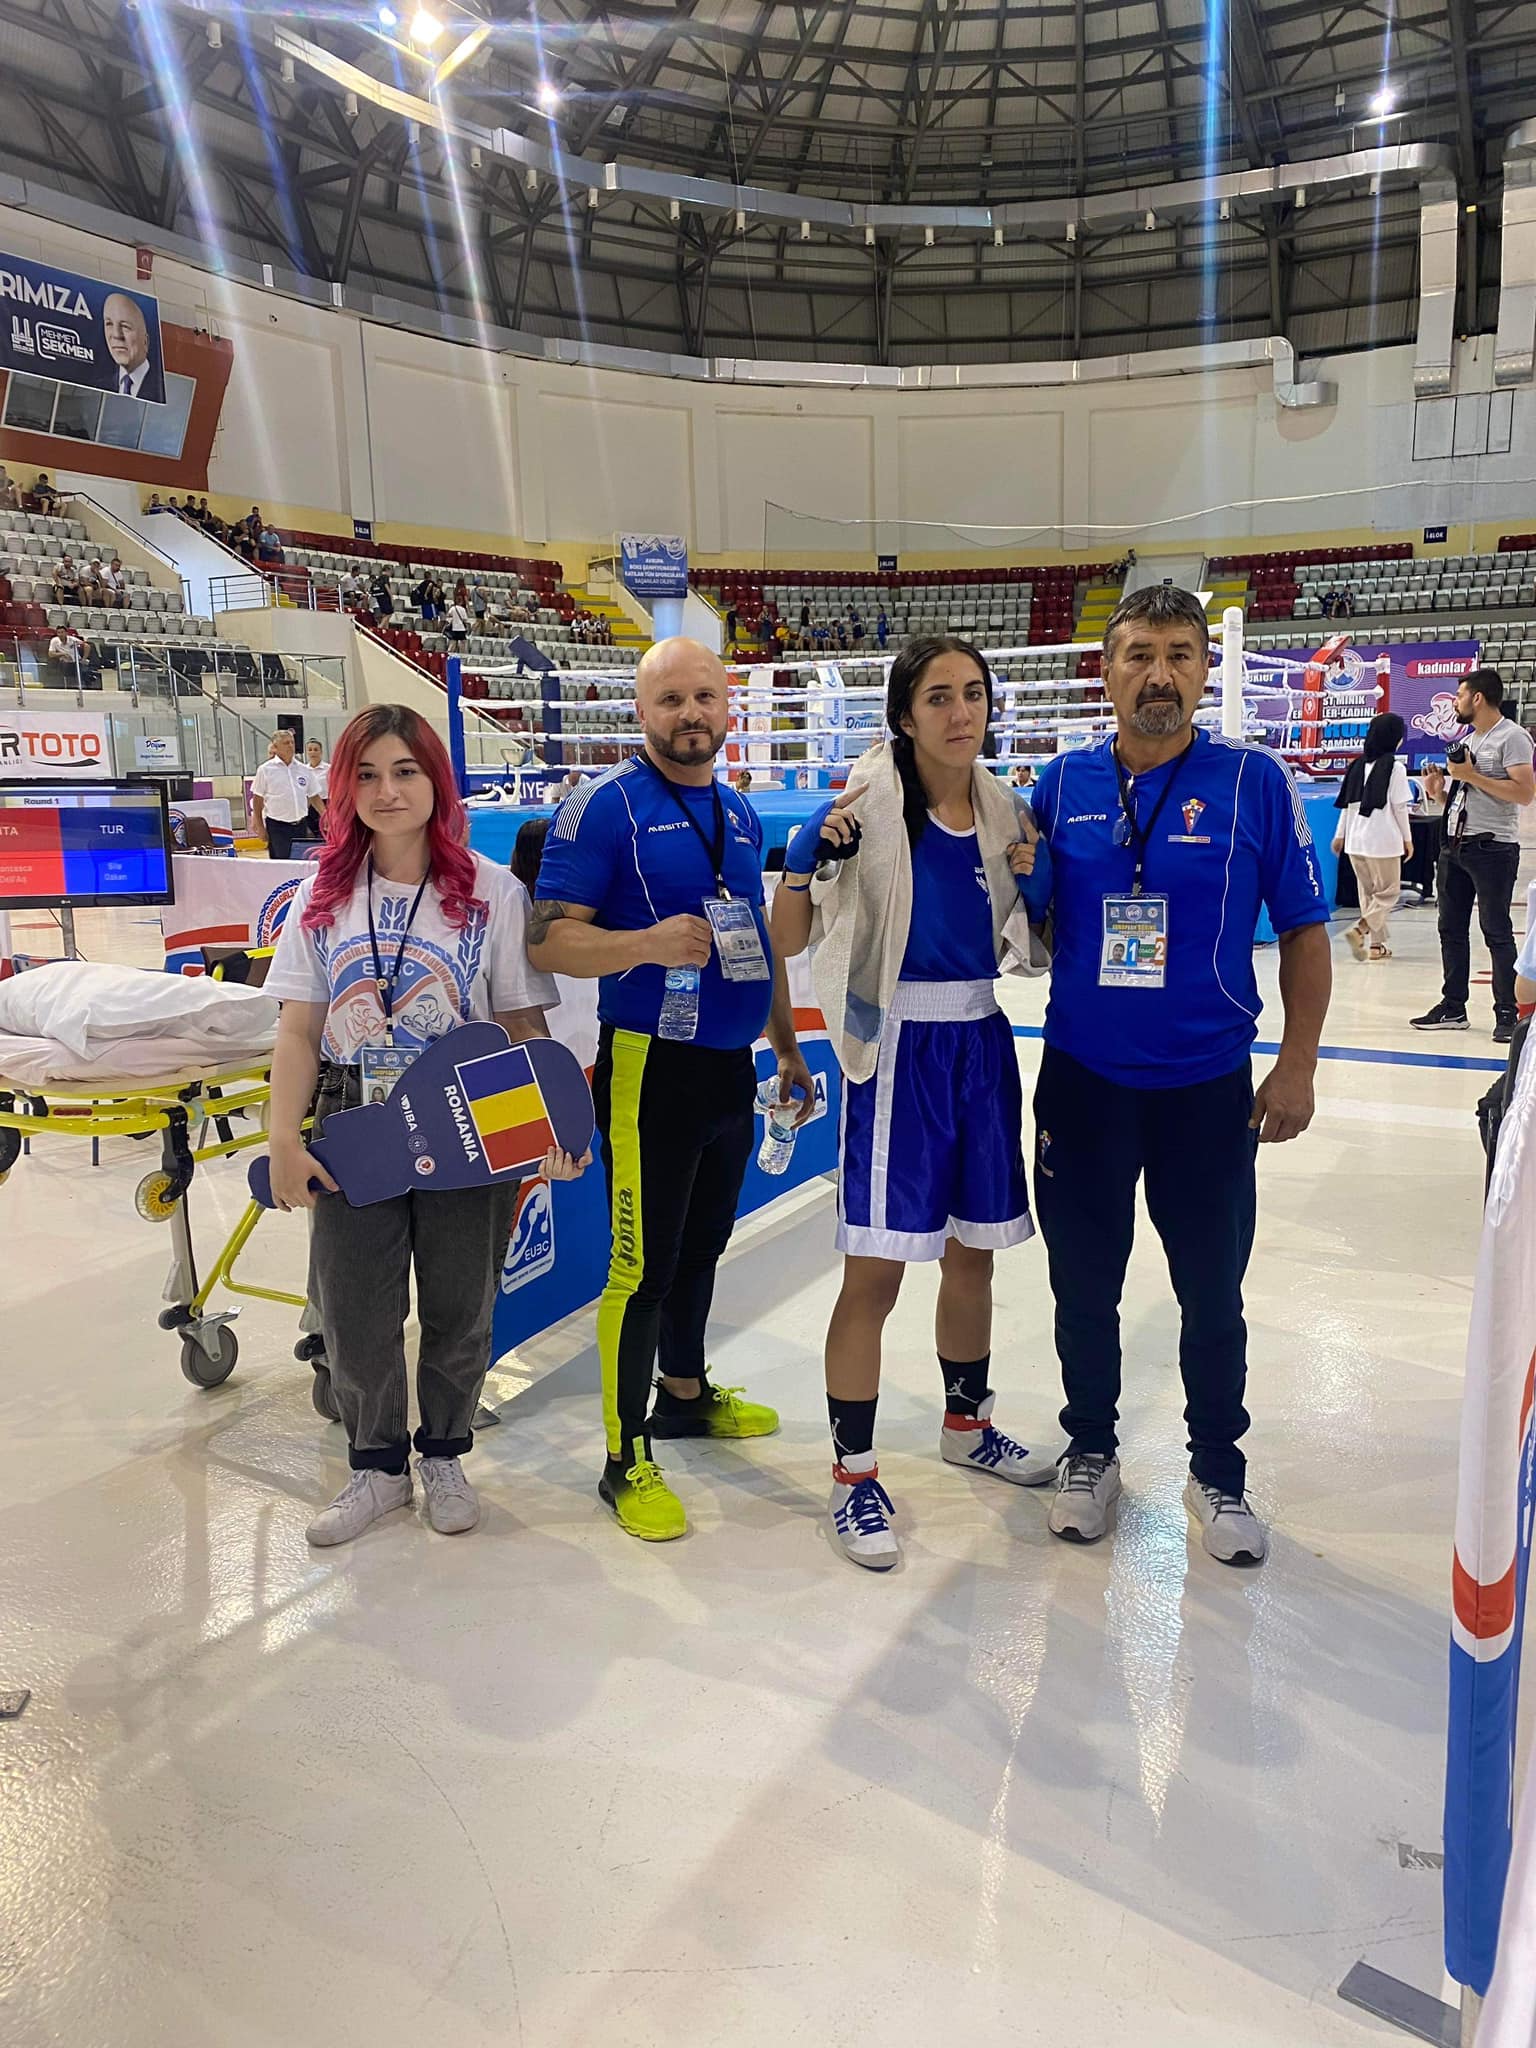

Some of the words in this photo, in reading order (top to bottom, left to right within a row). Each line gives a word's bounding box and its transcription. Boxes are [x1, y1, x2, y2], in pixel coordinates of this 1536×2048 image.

[40, 328, 77, 345] MEHMET
[42, 338, 94, 360] SEKMEN
[1417, 662, 1467, 675] kadınlar
[24, 797, 53, 805] Round
[99, 825, 125, 834] TUR
[1129, 942, 1137, 962] 1
[1154, 941, 1164, 961] 2
[403, 1110, 418, 1132] IBA
[443, 1084, 480, 1164] ROMANIA
